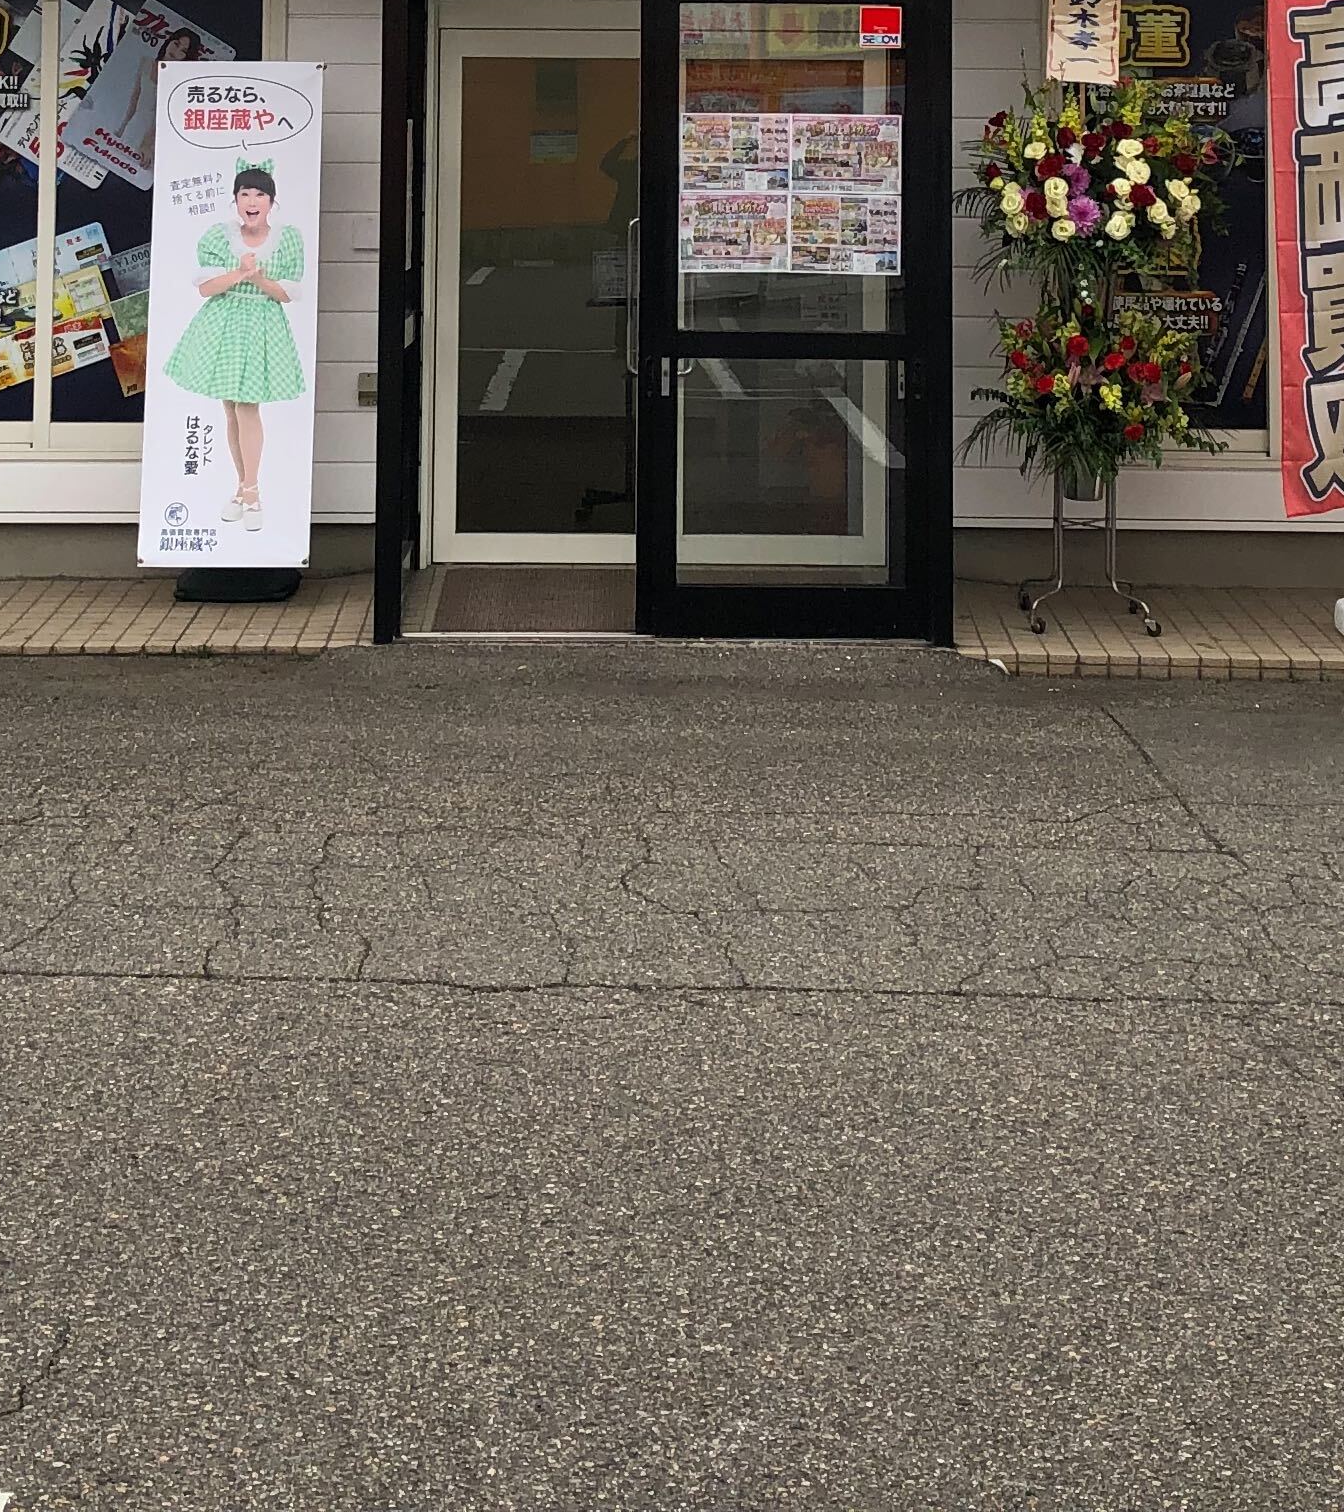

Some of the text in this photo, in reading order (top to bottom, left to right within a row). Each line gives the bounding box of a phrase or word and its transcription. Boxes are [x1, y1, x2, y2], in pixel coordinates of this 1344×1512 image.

[862, 34, 900, 45] SECOM
[187, 86, 266, 104] 売るなら、
[183, 108, 294, 131] 銀座蔵やへ
[183, 415, 201, 476] はるな愛
[203, 424, 214, 467] タレント
